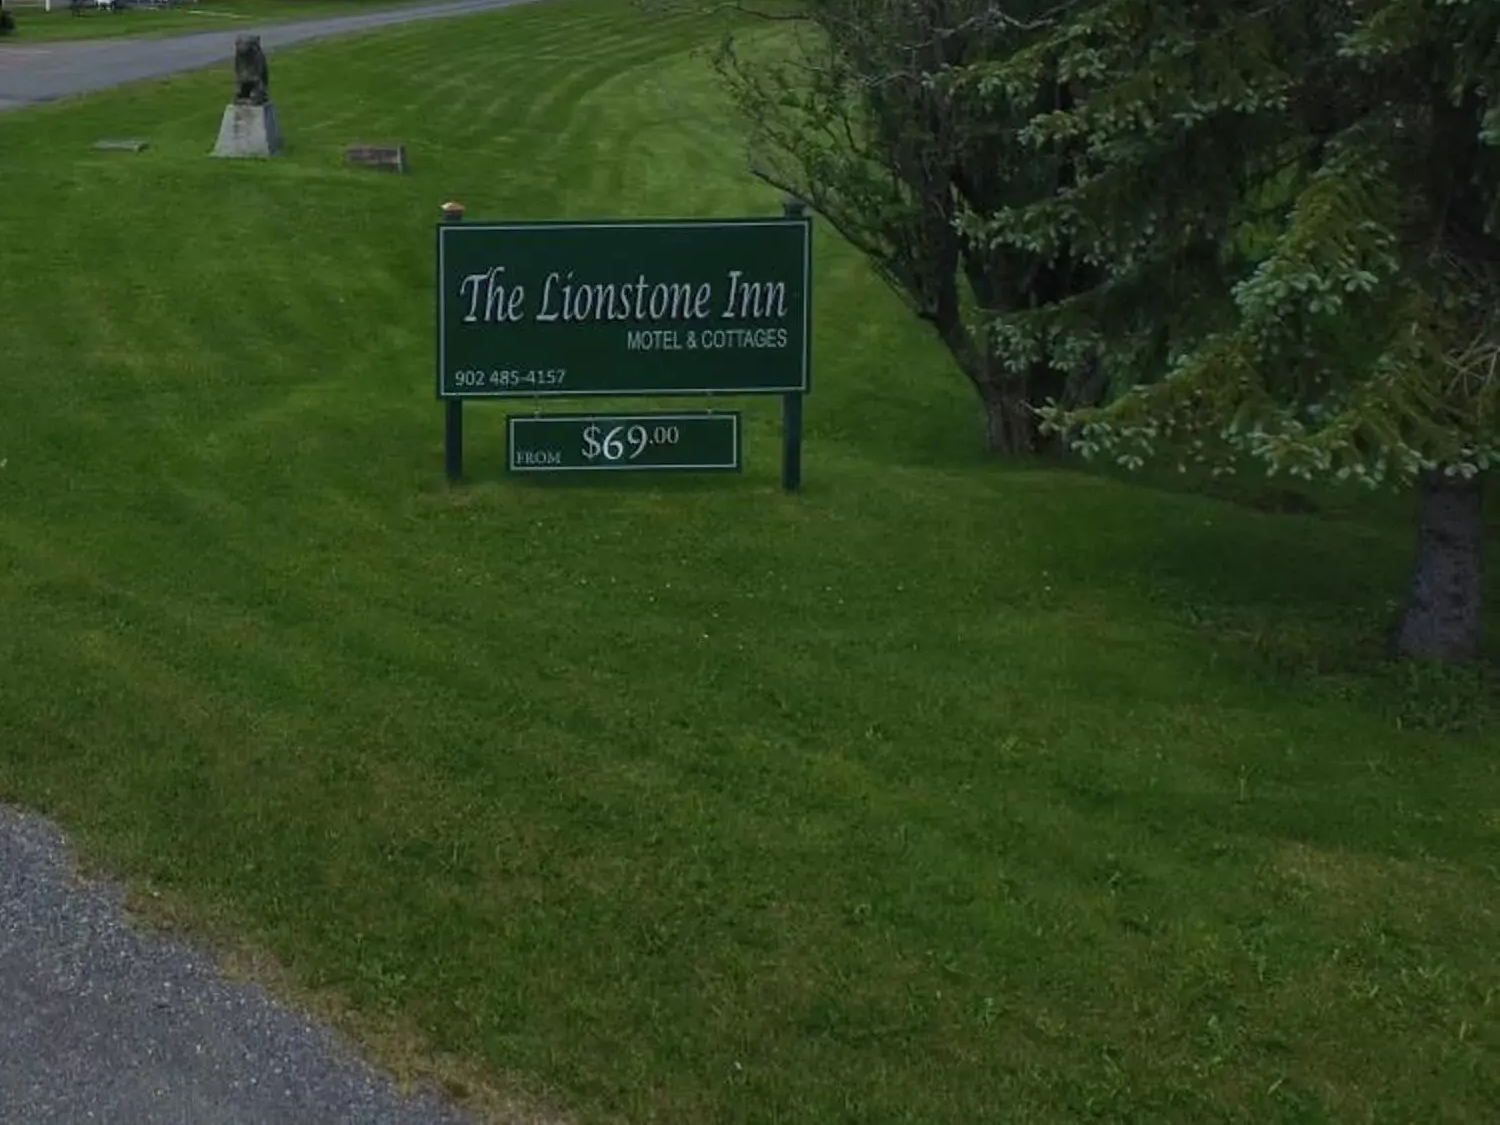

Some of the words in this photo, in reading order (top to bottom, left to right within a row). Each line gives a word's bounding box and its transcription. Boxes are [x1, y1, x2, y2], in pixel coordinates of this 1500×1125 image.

[460, 266, 525, 322] The
[536, 268, 712, 322] Lionstone
[722, 270, 788, 319] Inn
[627, 330, 682, 350] MOTEL
[687, 331, 698, 349] &
[701, 328, 788, 349] COTTAGES
[455, 371, 485, 387] 902
[489, 369, 566, 387] 485-4157
[516, 450, 562, 465] FROM
